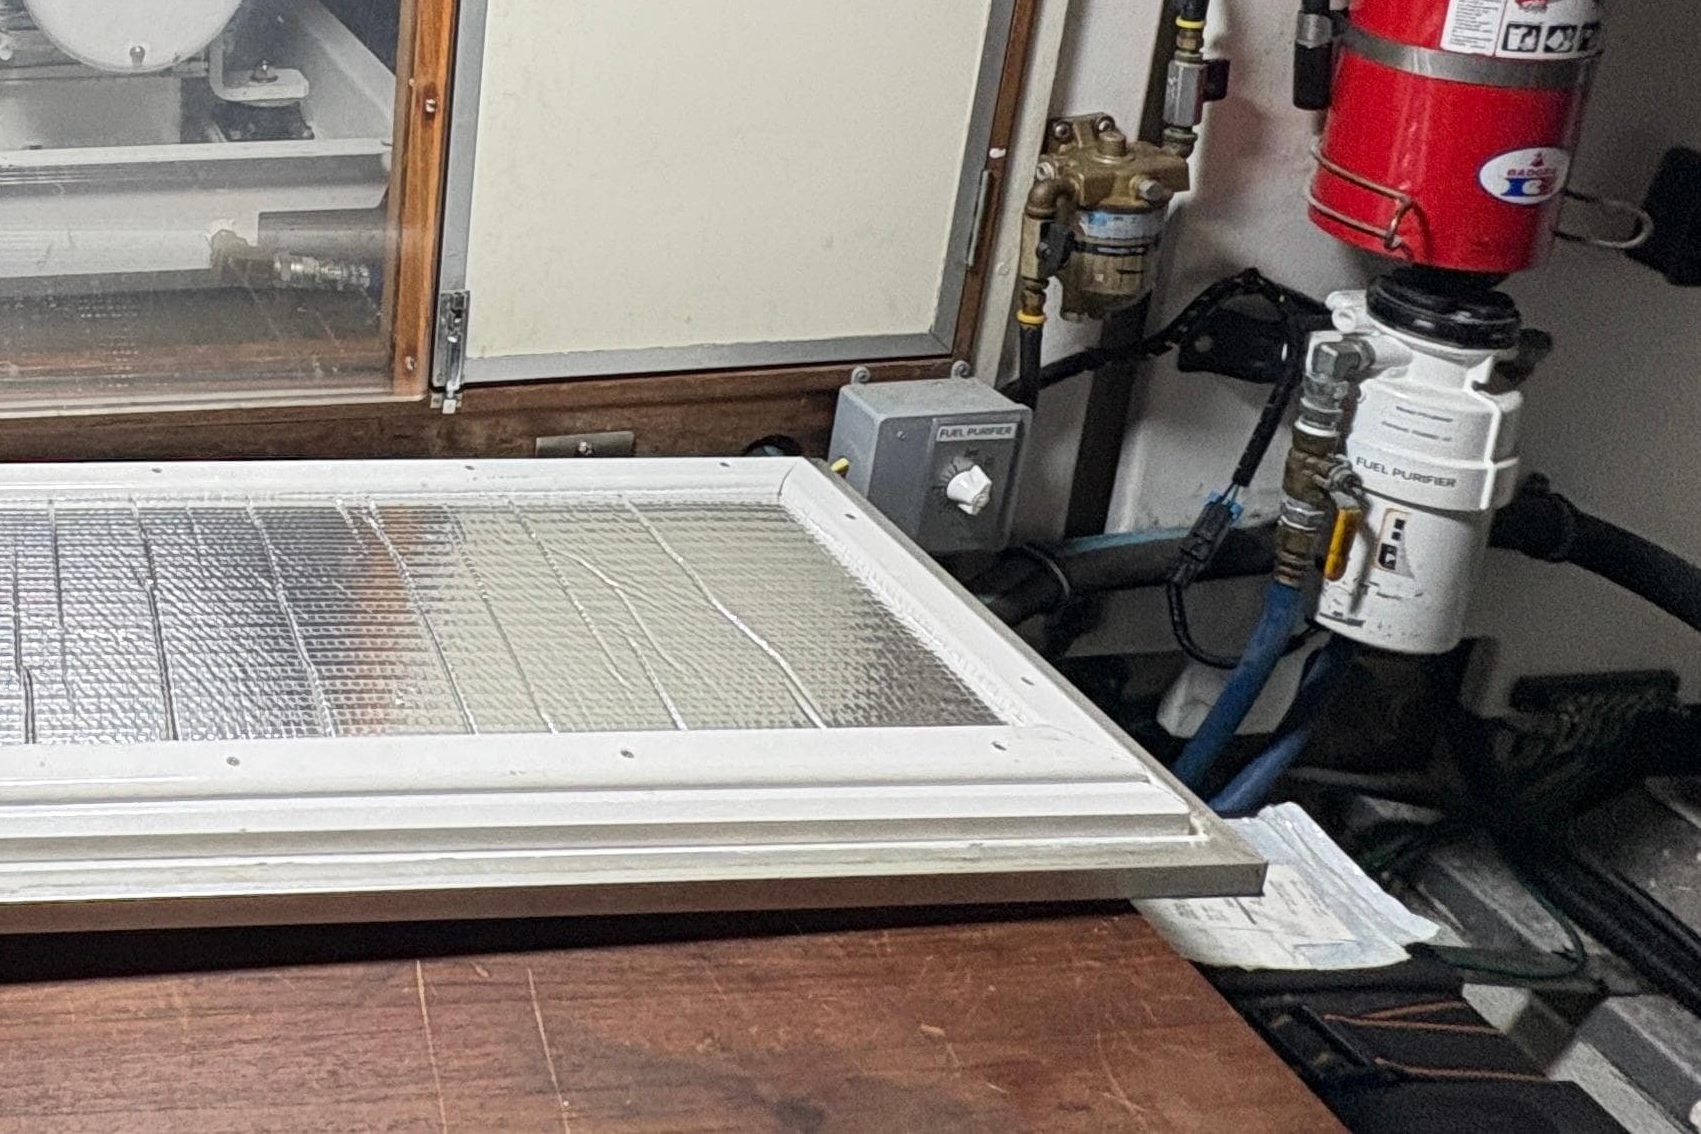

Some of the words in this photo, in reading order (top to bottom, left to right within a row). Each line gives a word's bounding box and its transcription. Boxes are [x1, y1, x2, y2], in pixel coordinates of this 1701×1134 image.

[939, 428, 963, 438] FUEL
[967, 426, 1012, 436] PURIFIER
[1356, 456, 1389, 475] FUEL
[1392, 467, 1457, 487] PURIFIER
